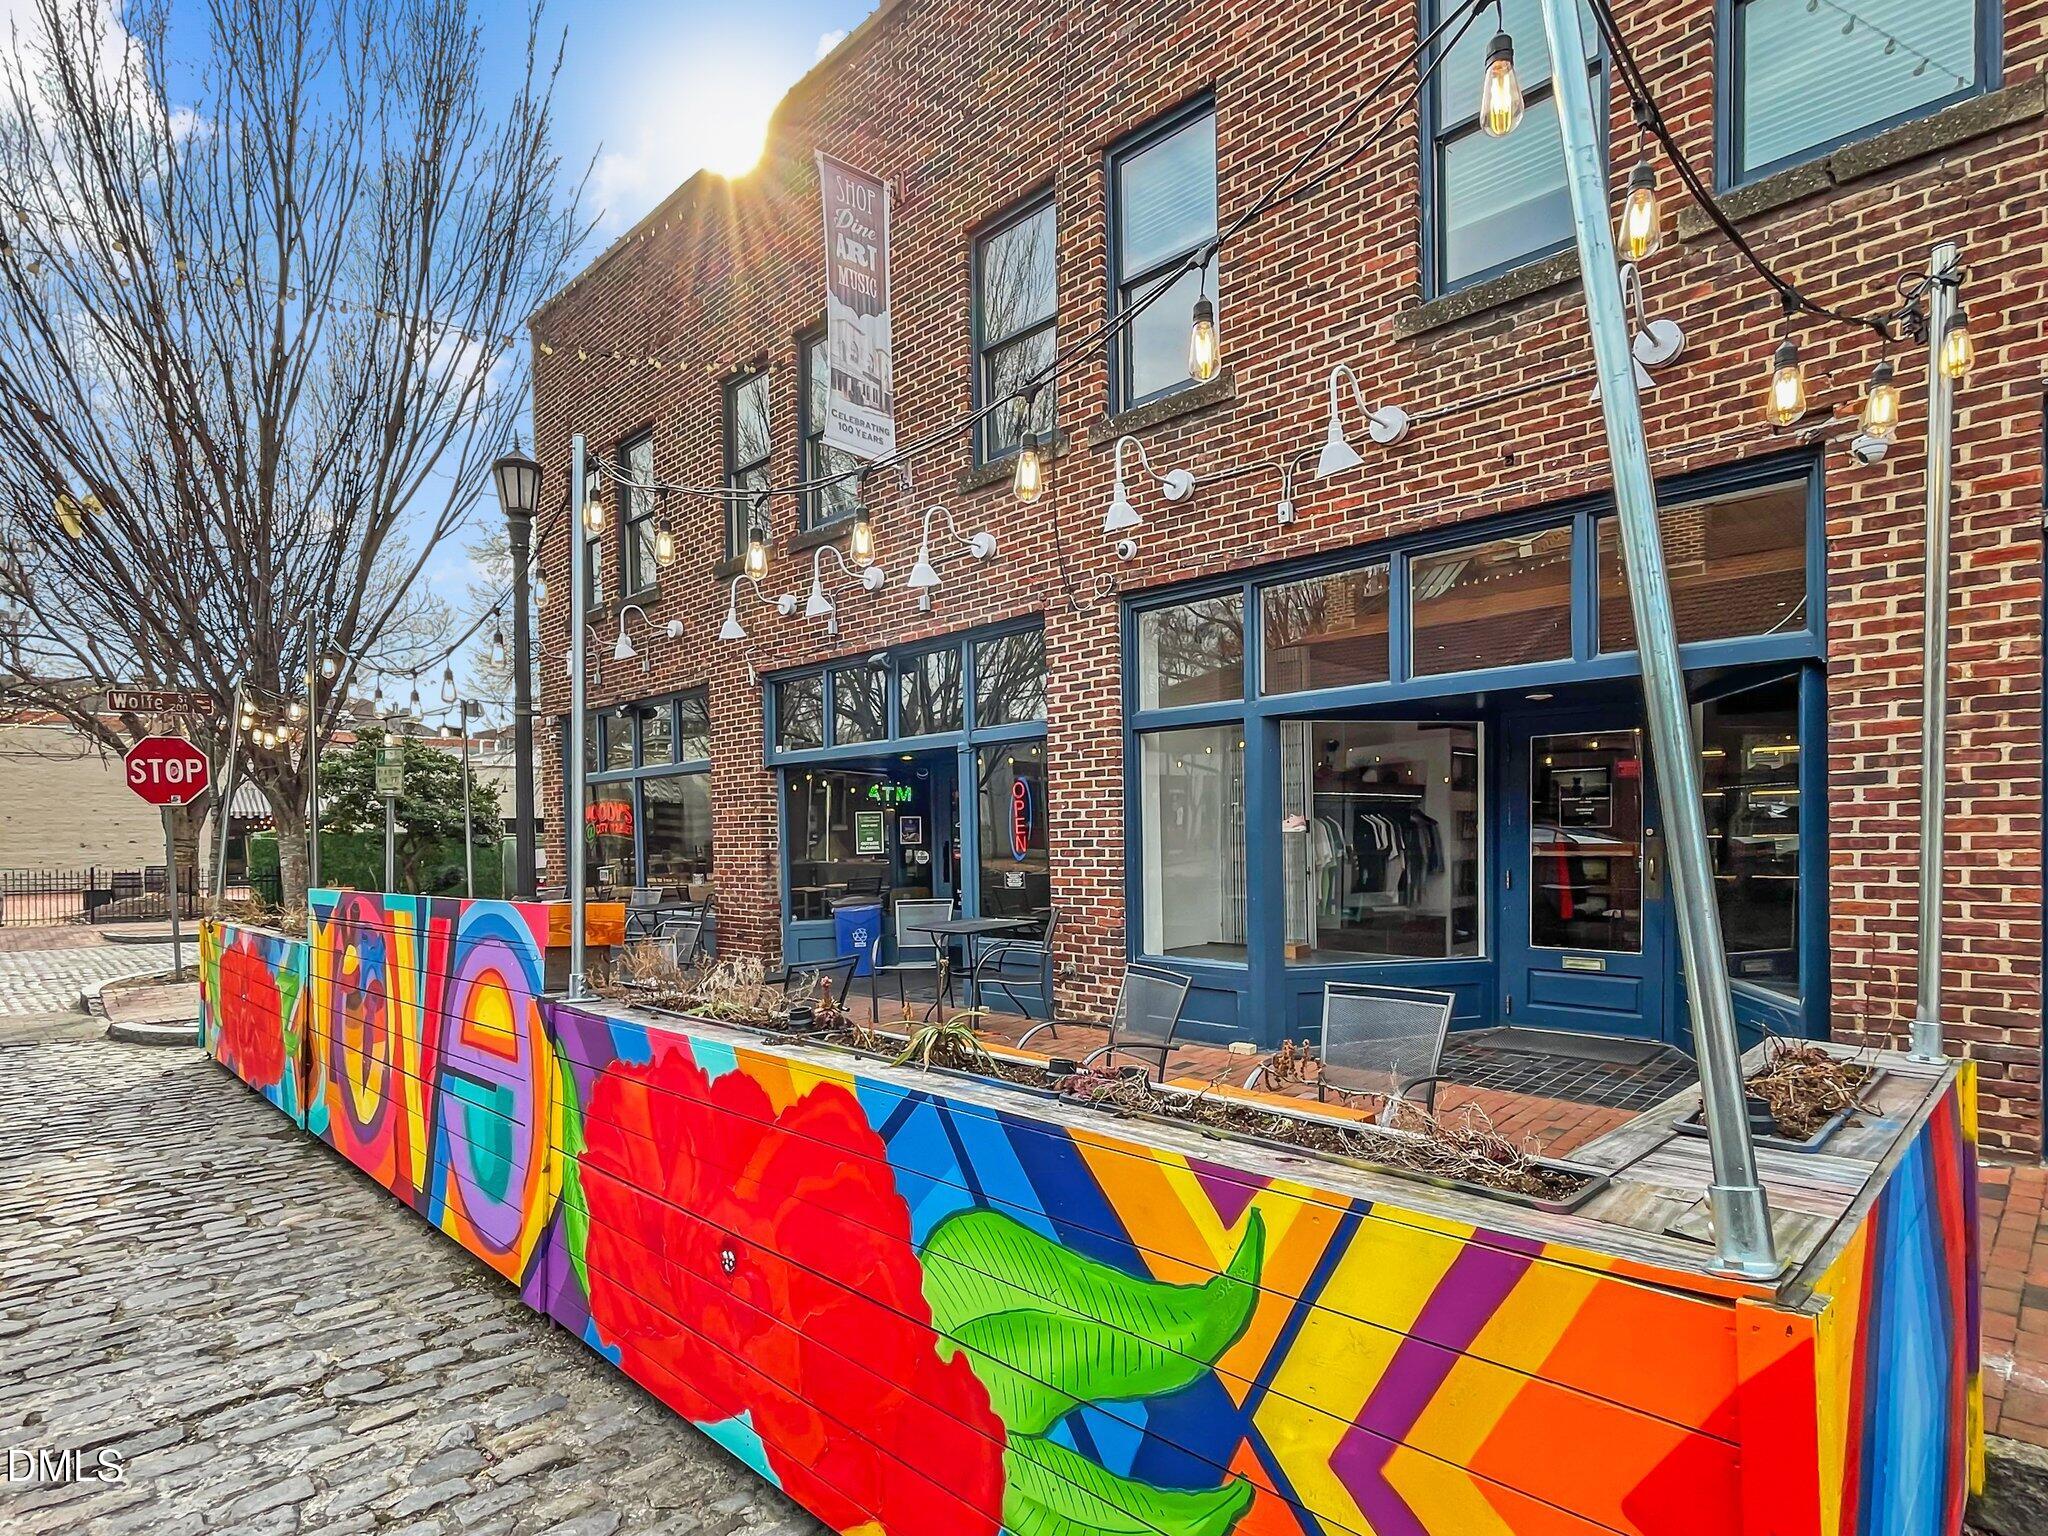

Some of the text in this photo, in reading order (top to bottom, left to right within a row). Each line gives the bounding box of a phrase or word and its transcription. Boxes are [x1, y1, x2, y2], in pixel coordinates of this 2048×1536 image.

[836, 175, 875, 215] SHOP
[834, 208, 877, 240] Dine
[836, 232, 877, 272] ART
[837, 264, 877, 299] MUSIC
[831, 408, 890, 436] CELEBRATING
[838, 421, 884, 446] 100 YEARS
[113, 692, 163, 710] Wolfe
[130, 758, 203, 784] STOP
[868, 784, 912, 801] ATM
[1012, 781, 1027, 853] OPEN
